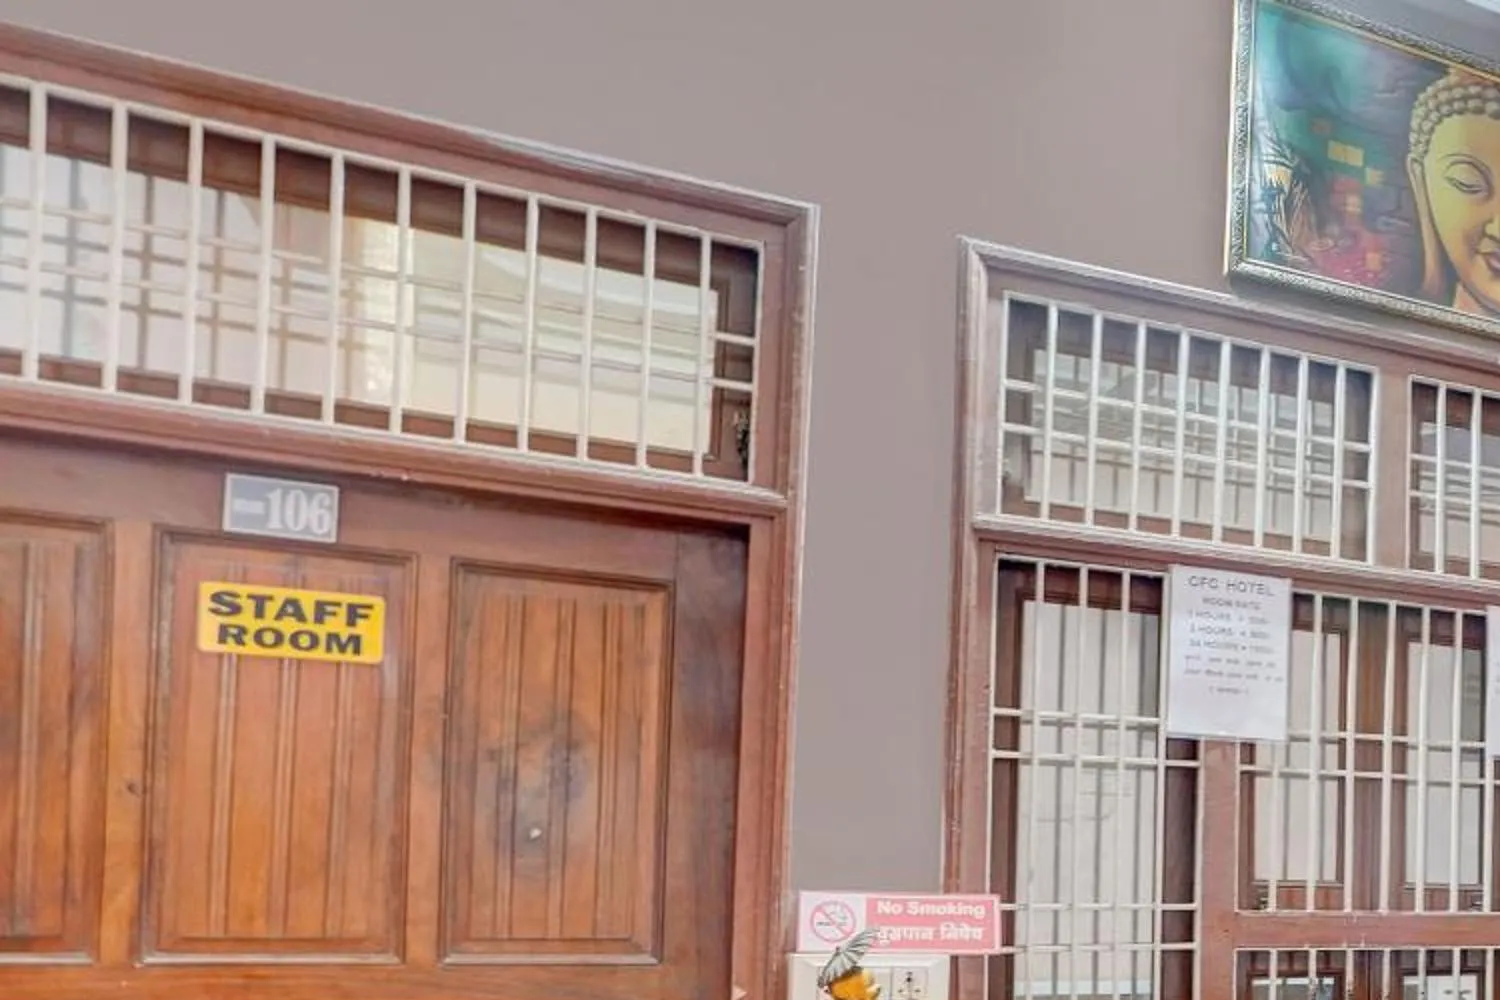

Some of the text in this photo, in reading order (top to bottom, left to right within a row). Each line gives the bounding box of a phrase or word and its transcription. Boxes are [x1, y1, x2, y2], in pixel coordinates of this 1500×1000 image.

[1226, 580, 1275, 597] HOTEL
[208, 590, 374, 628] STAFF
[217, 623, 363, 656] ROOM
[877, 900, 986, 919] No Smoking
